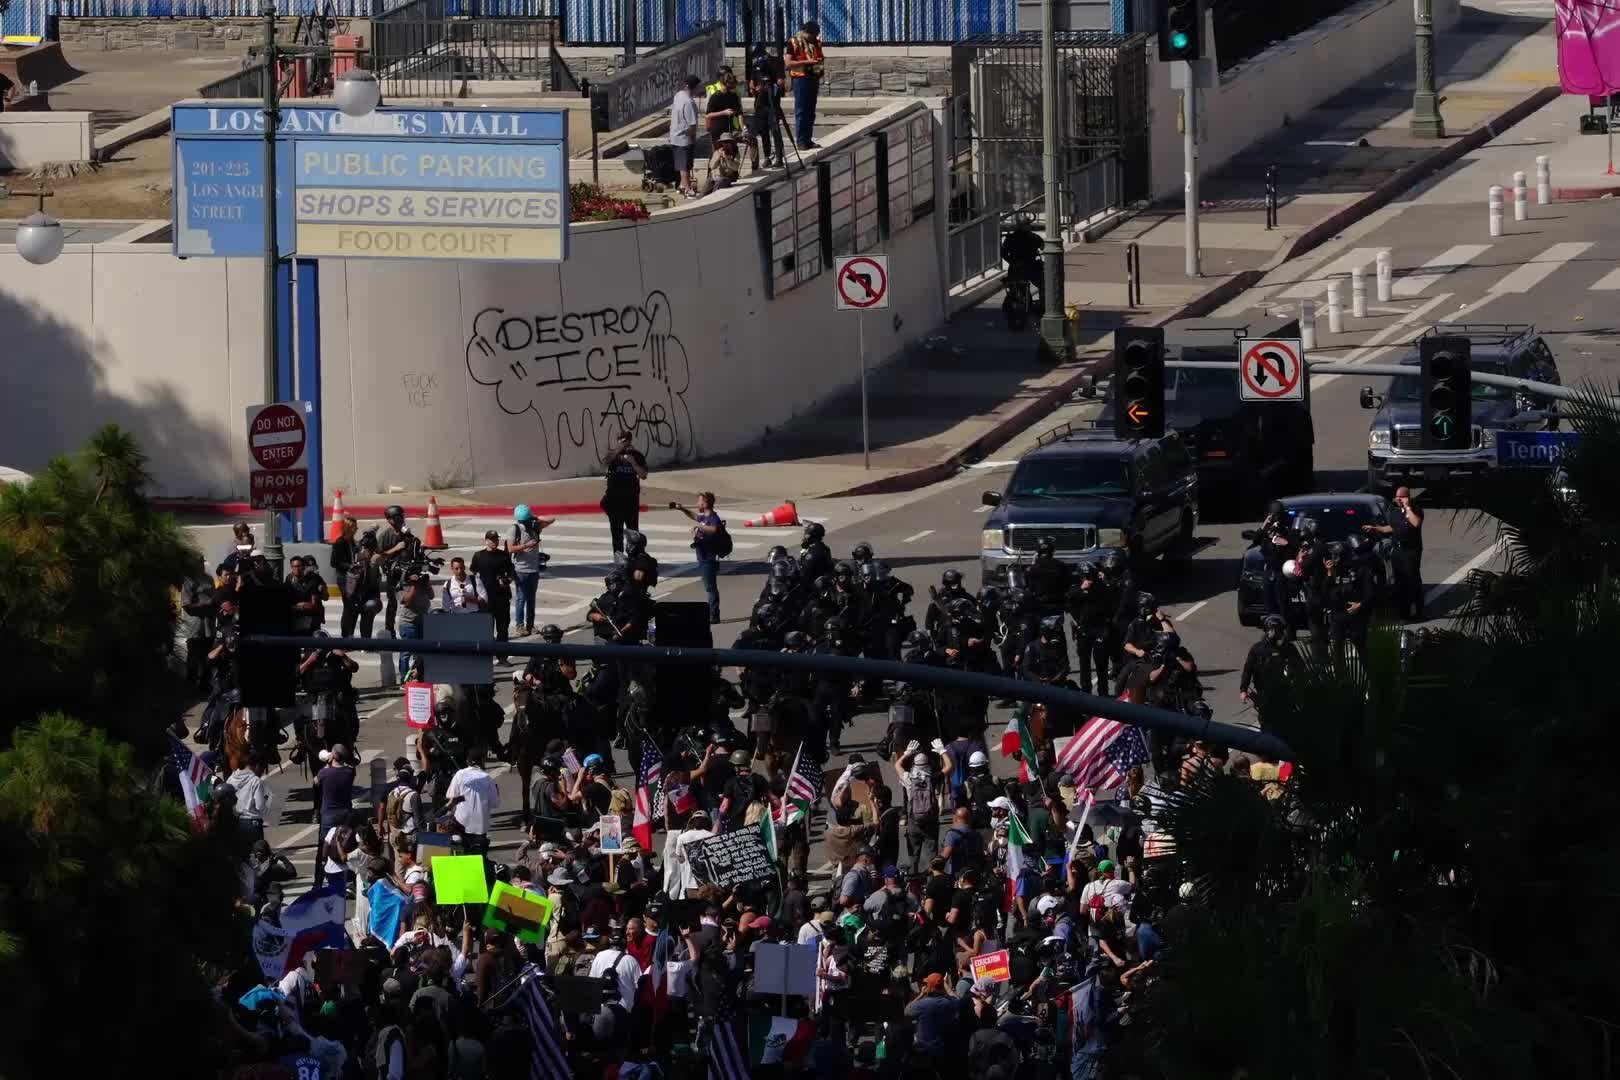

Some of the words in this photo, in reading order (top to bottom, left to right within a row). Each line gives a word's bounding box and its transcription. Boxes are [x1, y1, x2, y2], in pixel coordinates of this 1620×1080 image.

[207, 108, 264, 131] LOS
[440, 112, 528, 136] MALL
[304, 152, 408, 176] PUBLIC
[419, 154, 546, 179] PARKING
[192, 183, 221, 197] LOS
[192, 205, 242, 219] STREET
[300, 194, 391, 217] SHOPS
[398, 196, 415, 217] &
[424, 197, 558, 219] SERVICES
[338, 230, 411, 251] FOOD
[422, 232, 513, 253] COURT
[496, 303, 659, 350] DESTROY
[408, 391, 432, 408] ICE
[257, 419, 271, 430] DO
[277, 415, 296, 428] NOT
[600, 391, 674, 448] ACAB
[262, 447, 294, 461] ENTER
[1506, 440, 1568, 463] Temp
[254, 474, 305, 488] WRONG
[263, 491, 296, 505] WAY
